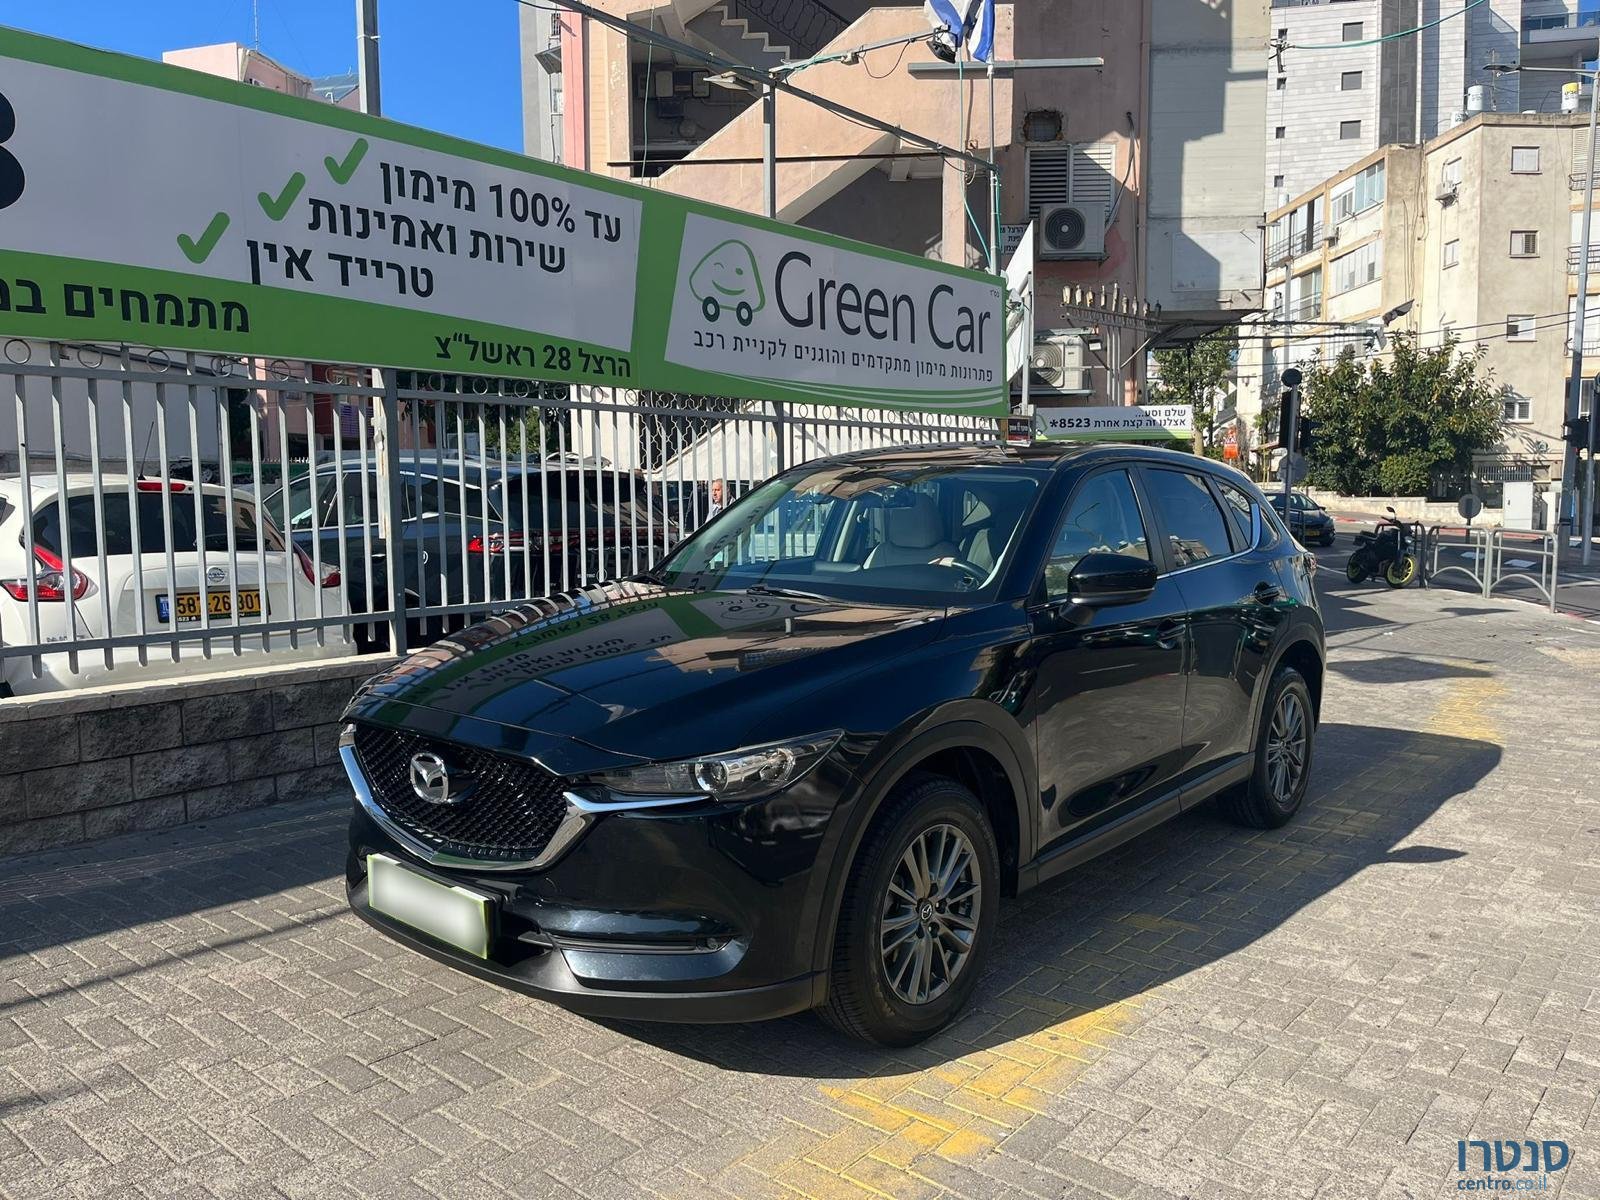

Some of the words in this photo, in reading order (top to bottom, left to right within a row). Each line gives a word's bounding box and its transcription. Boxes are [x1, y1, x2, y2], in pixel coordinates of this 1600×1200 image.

[379, 161, 476, 212] מימון
[489, 183, 576, 233] 100%
[308, 197, 457, 256] ואמינות
[585, 209, 621, 243] עד
[246, 239, 314, 285] אין
[469, 229, 566, 273] שירות
[328, 252, 434, 298] טרייד
[63, 283, 250, 333] מתמחים
[774, 251, 916, 344] Green
[928, 284, 991, 354] Car
[693, 330, 725, 350] רכב
[733, 335, 787, 360] לקניית
[543, 344, 572, 371] 28
[578, 348, 631, 377] הרצל
[794, 344, 846, 366] והוגנים
[852, 352, 911, 374] מתקדמים
[915, 360, 946, 378] מימון
[950, 363, 993, 383] פתרונות
[1094, 419, 1120, 428] אחרת
[1122, 419, 1143, 428] קצת
[1145, 419, 1156, 427] זה
[1159, 418, 1186, 426] אצלנו
[1165, 408, 1186, 417] שלם
